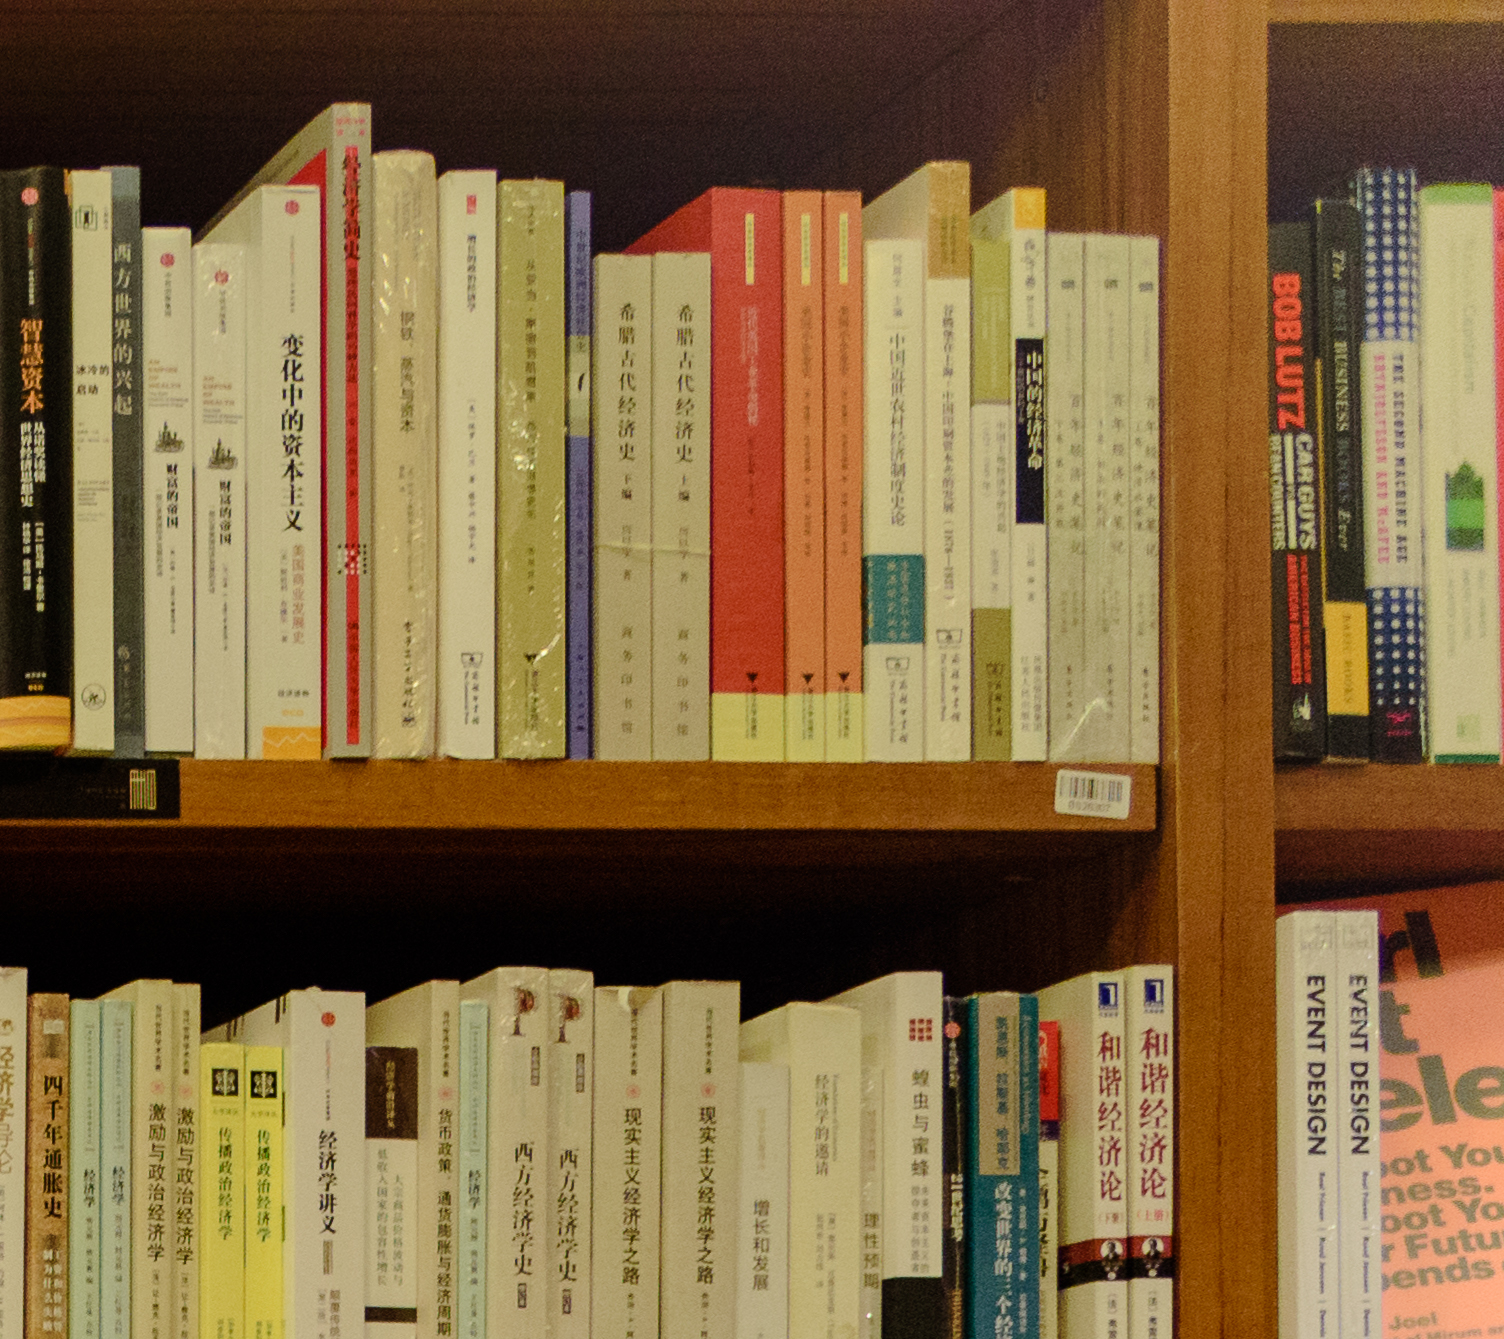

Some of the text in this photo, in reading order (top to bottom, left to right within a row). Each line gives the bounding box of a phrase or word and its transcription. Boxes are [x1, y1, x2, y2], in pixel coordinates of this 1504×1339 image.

[280, 333, 305, 531] 变化中的资本主义
[1272, 274, 1305, 428] BOB LUTZ
[42, 1075, 64, 1219] 四千年通胀史
[1097, 1030, 1122, 1202] 和谐经济论
[1307, 974, 1326, 1155] EVENT DESIGN
[1349, 974, 1368, 1155] EVENT DESIGN
[622, 1107, 642, 1286] 现实主义经济学之路
